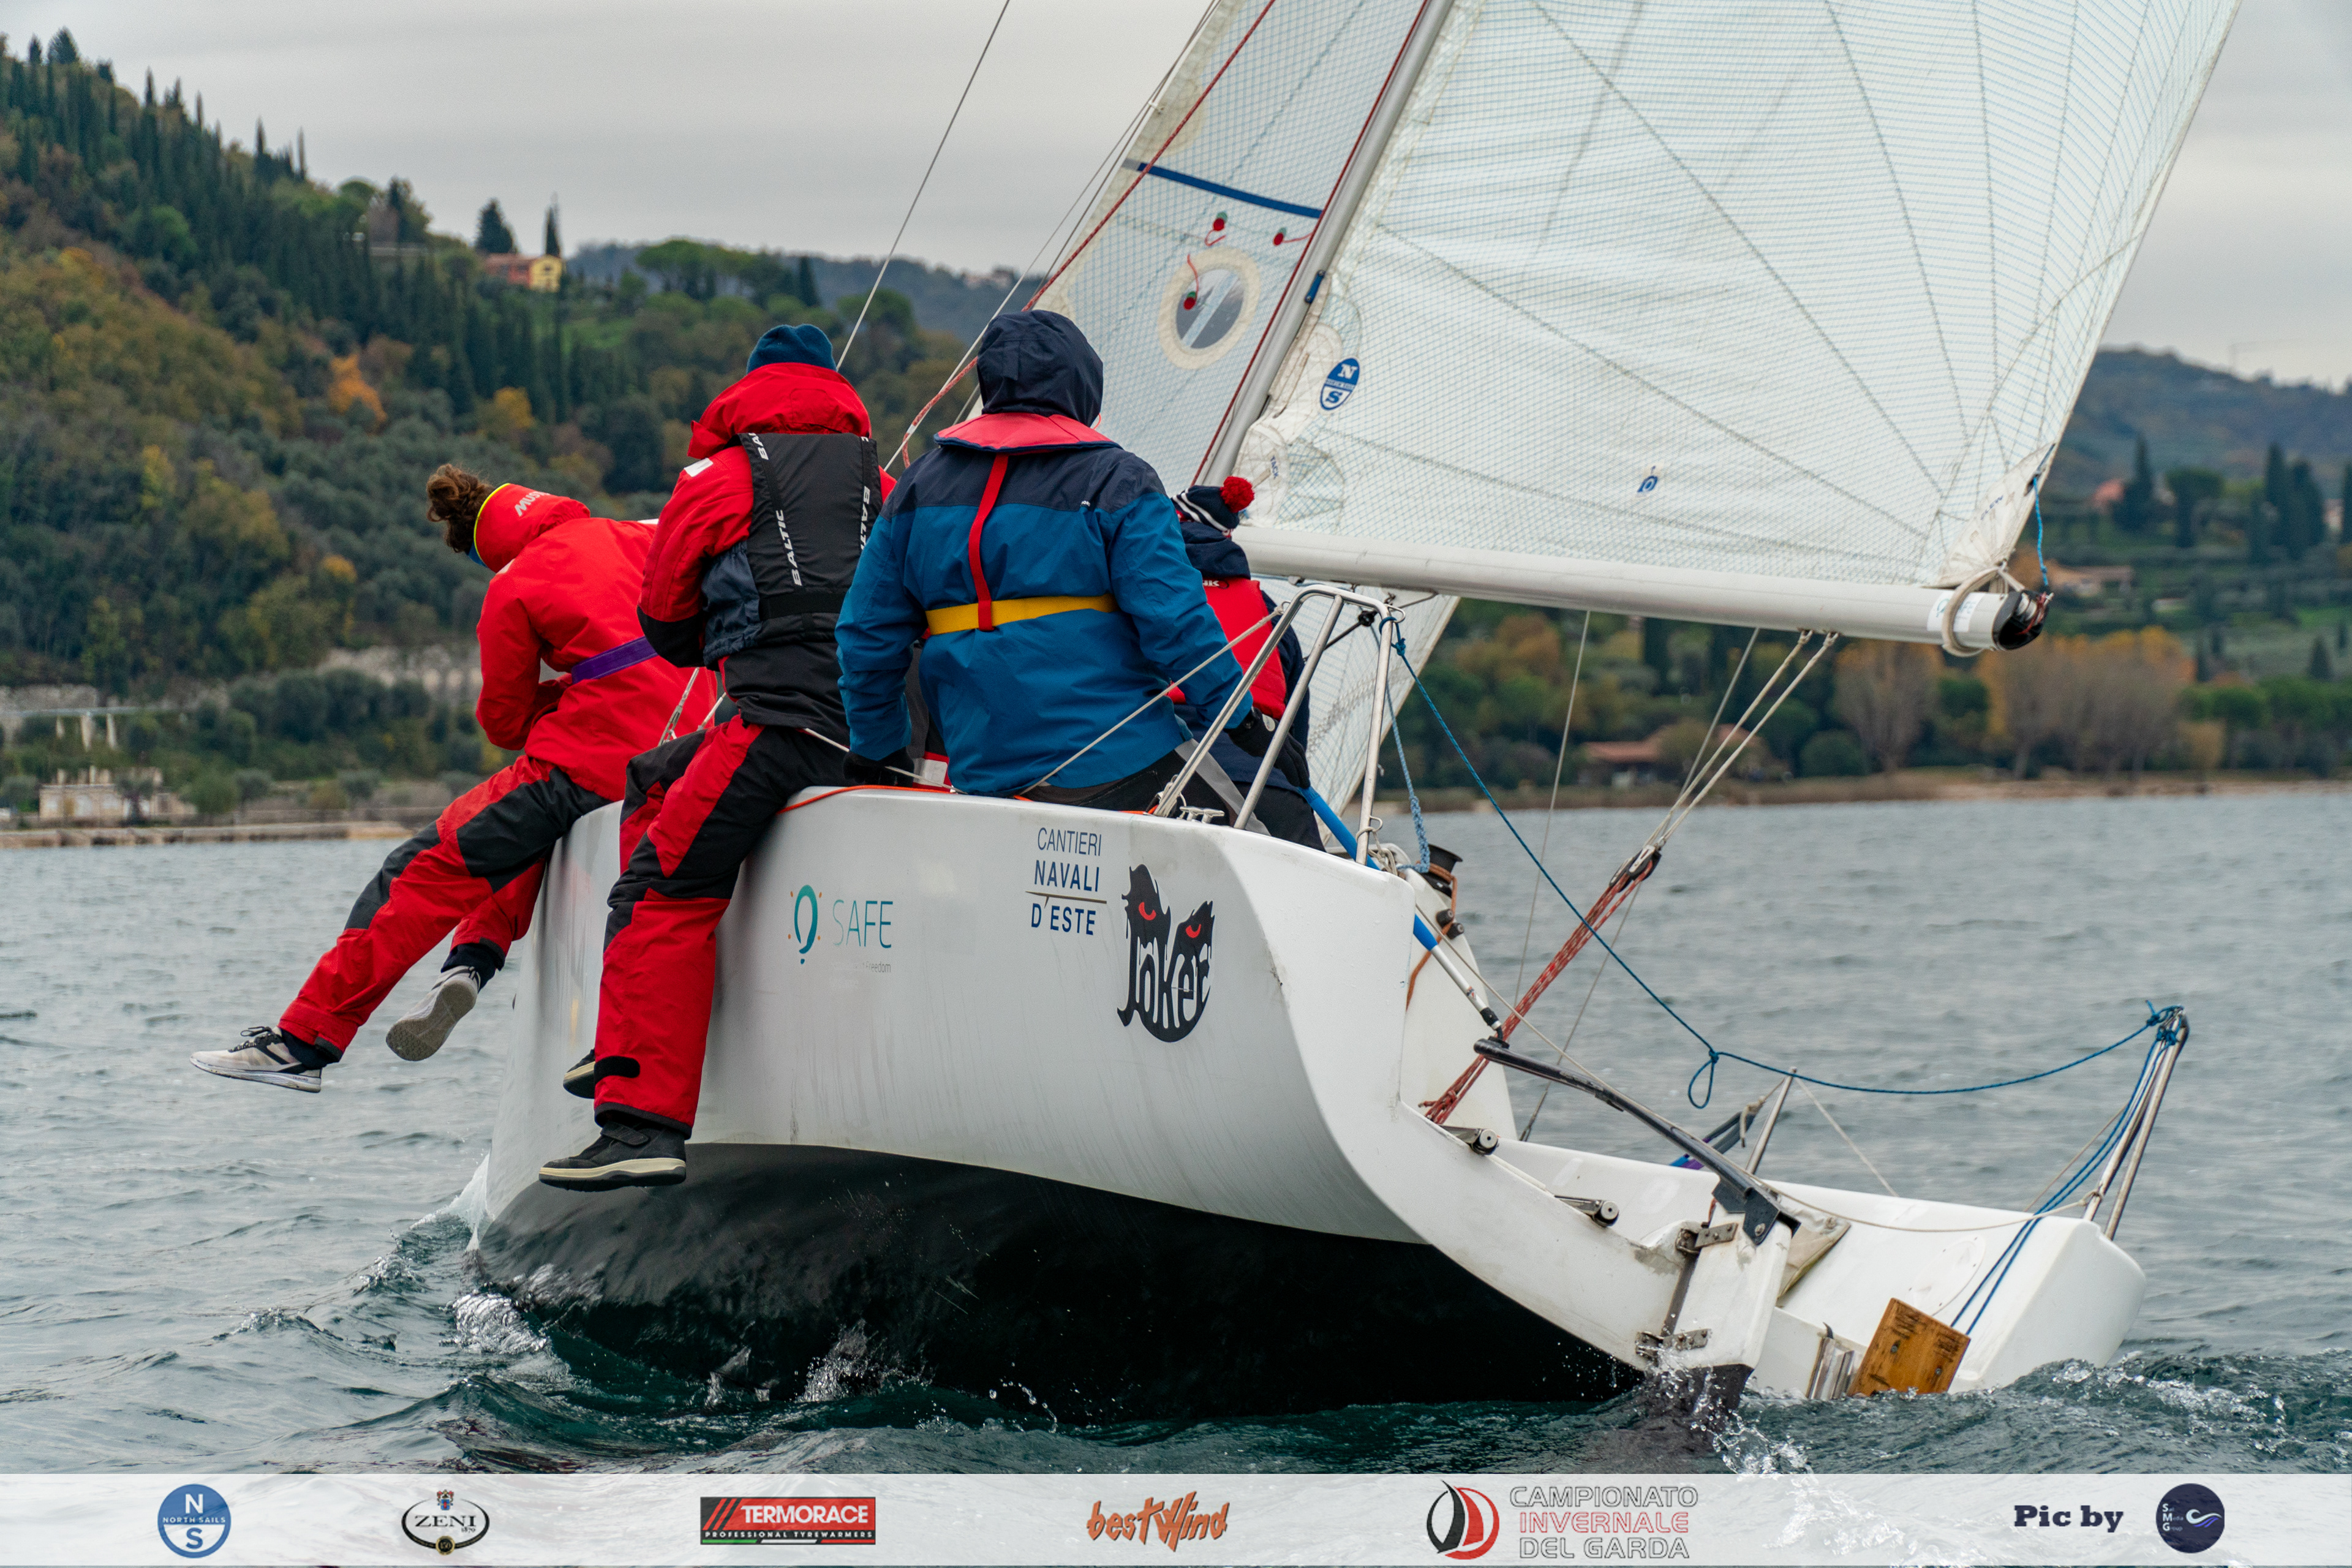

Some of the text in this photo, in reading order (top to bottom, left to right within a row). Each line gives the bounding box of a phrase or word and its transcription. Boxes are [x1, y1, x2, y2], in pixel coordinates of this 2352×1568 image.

[1337, 363, 1358, 380] N
[1325, 391, 1343, 404] S
[775, 510, 802, 586] BALTIC
[1038, 827, 1101, 856] CANTIERI
[1034, 859, 1099, 892] NAVALI
[832, 899, 894, 949] SAFE
